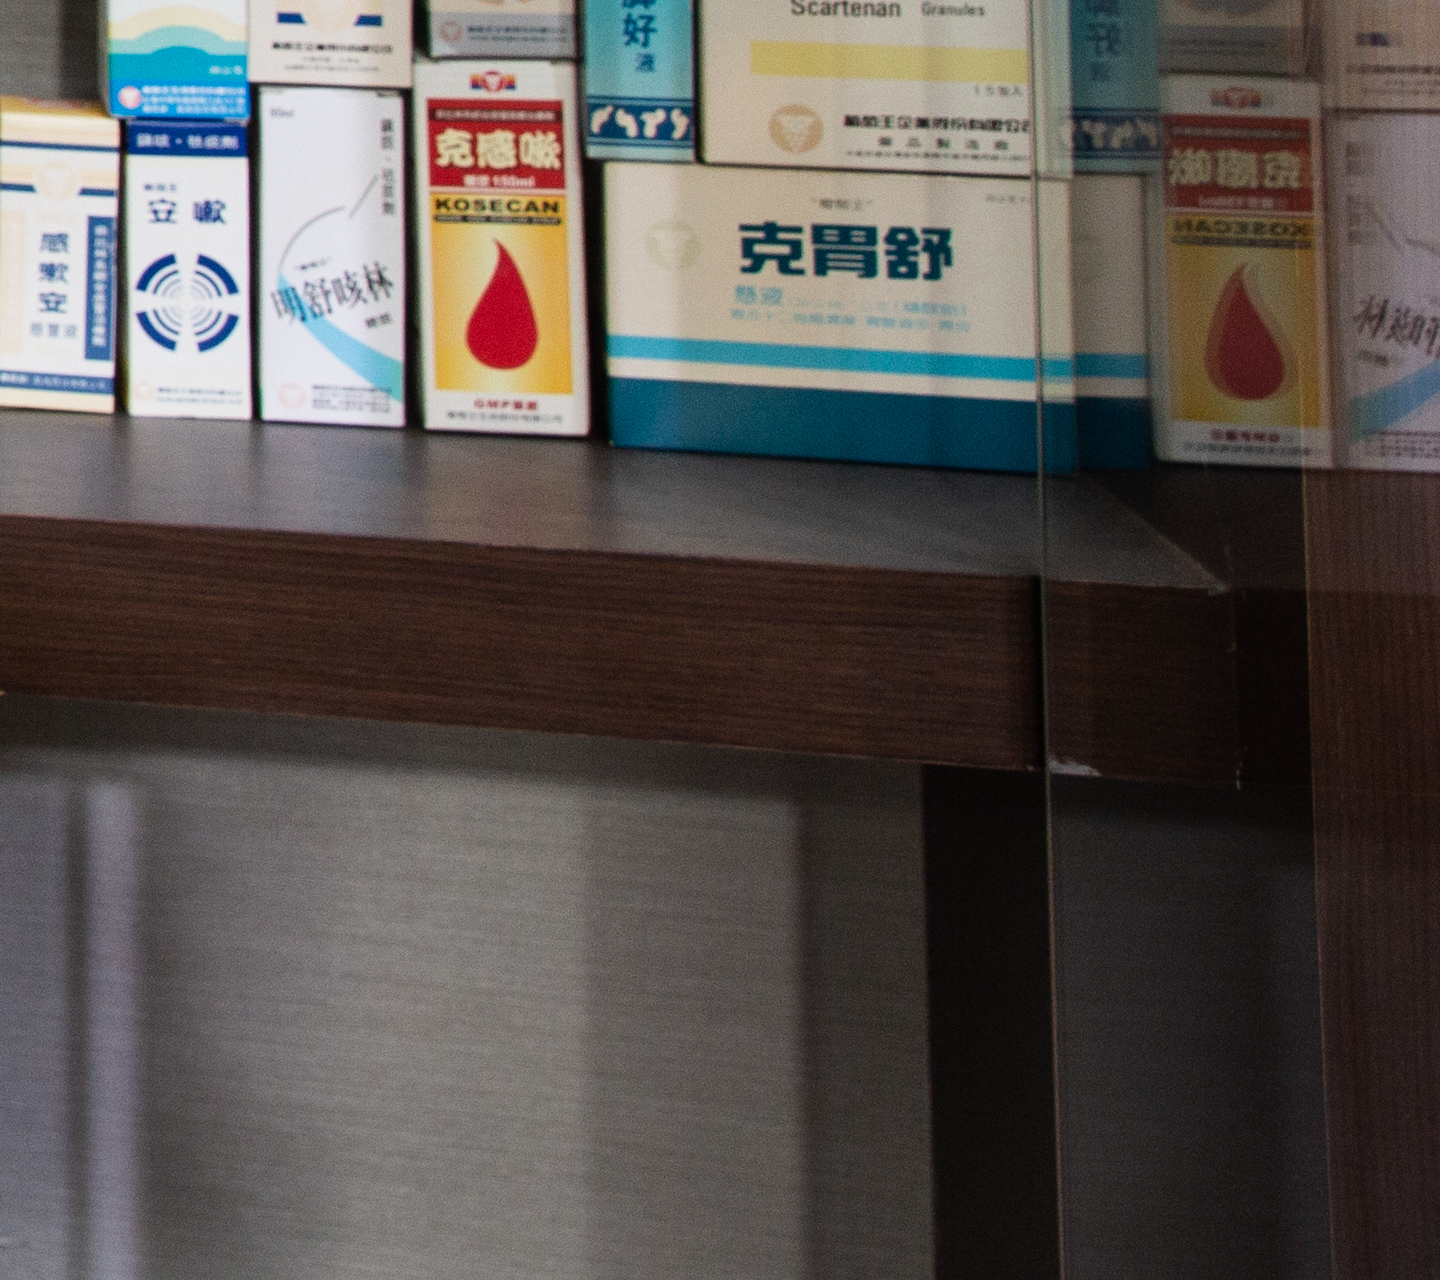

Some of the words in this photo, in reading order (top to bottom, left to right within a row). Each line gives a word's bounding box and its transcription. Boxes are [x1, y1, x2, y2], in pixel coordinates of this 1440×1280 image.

[921, 1, 985, 17] Granules
[434, 196, 561, 216] KOSECAN
[738, 220, 955, 281] 克胃舒
[271, 259, 395, 324] 明舒咳林
